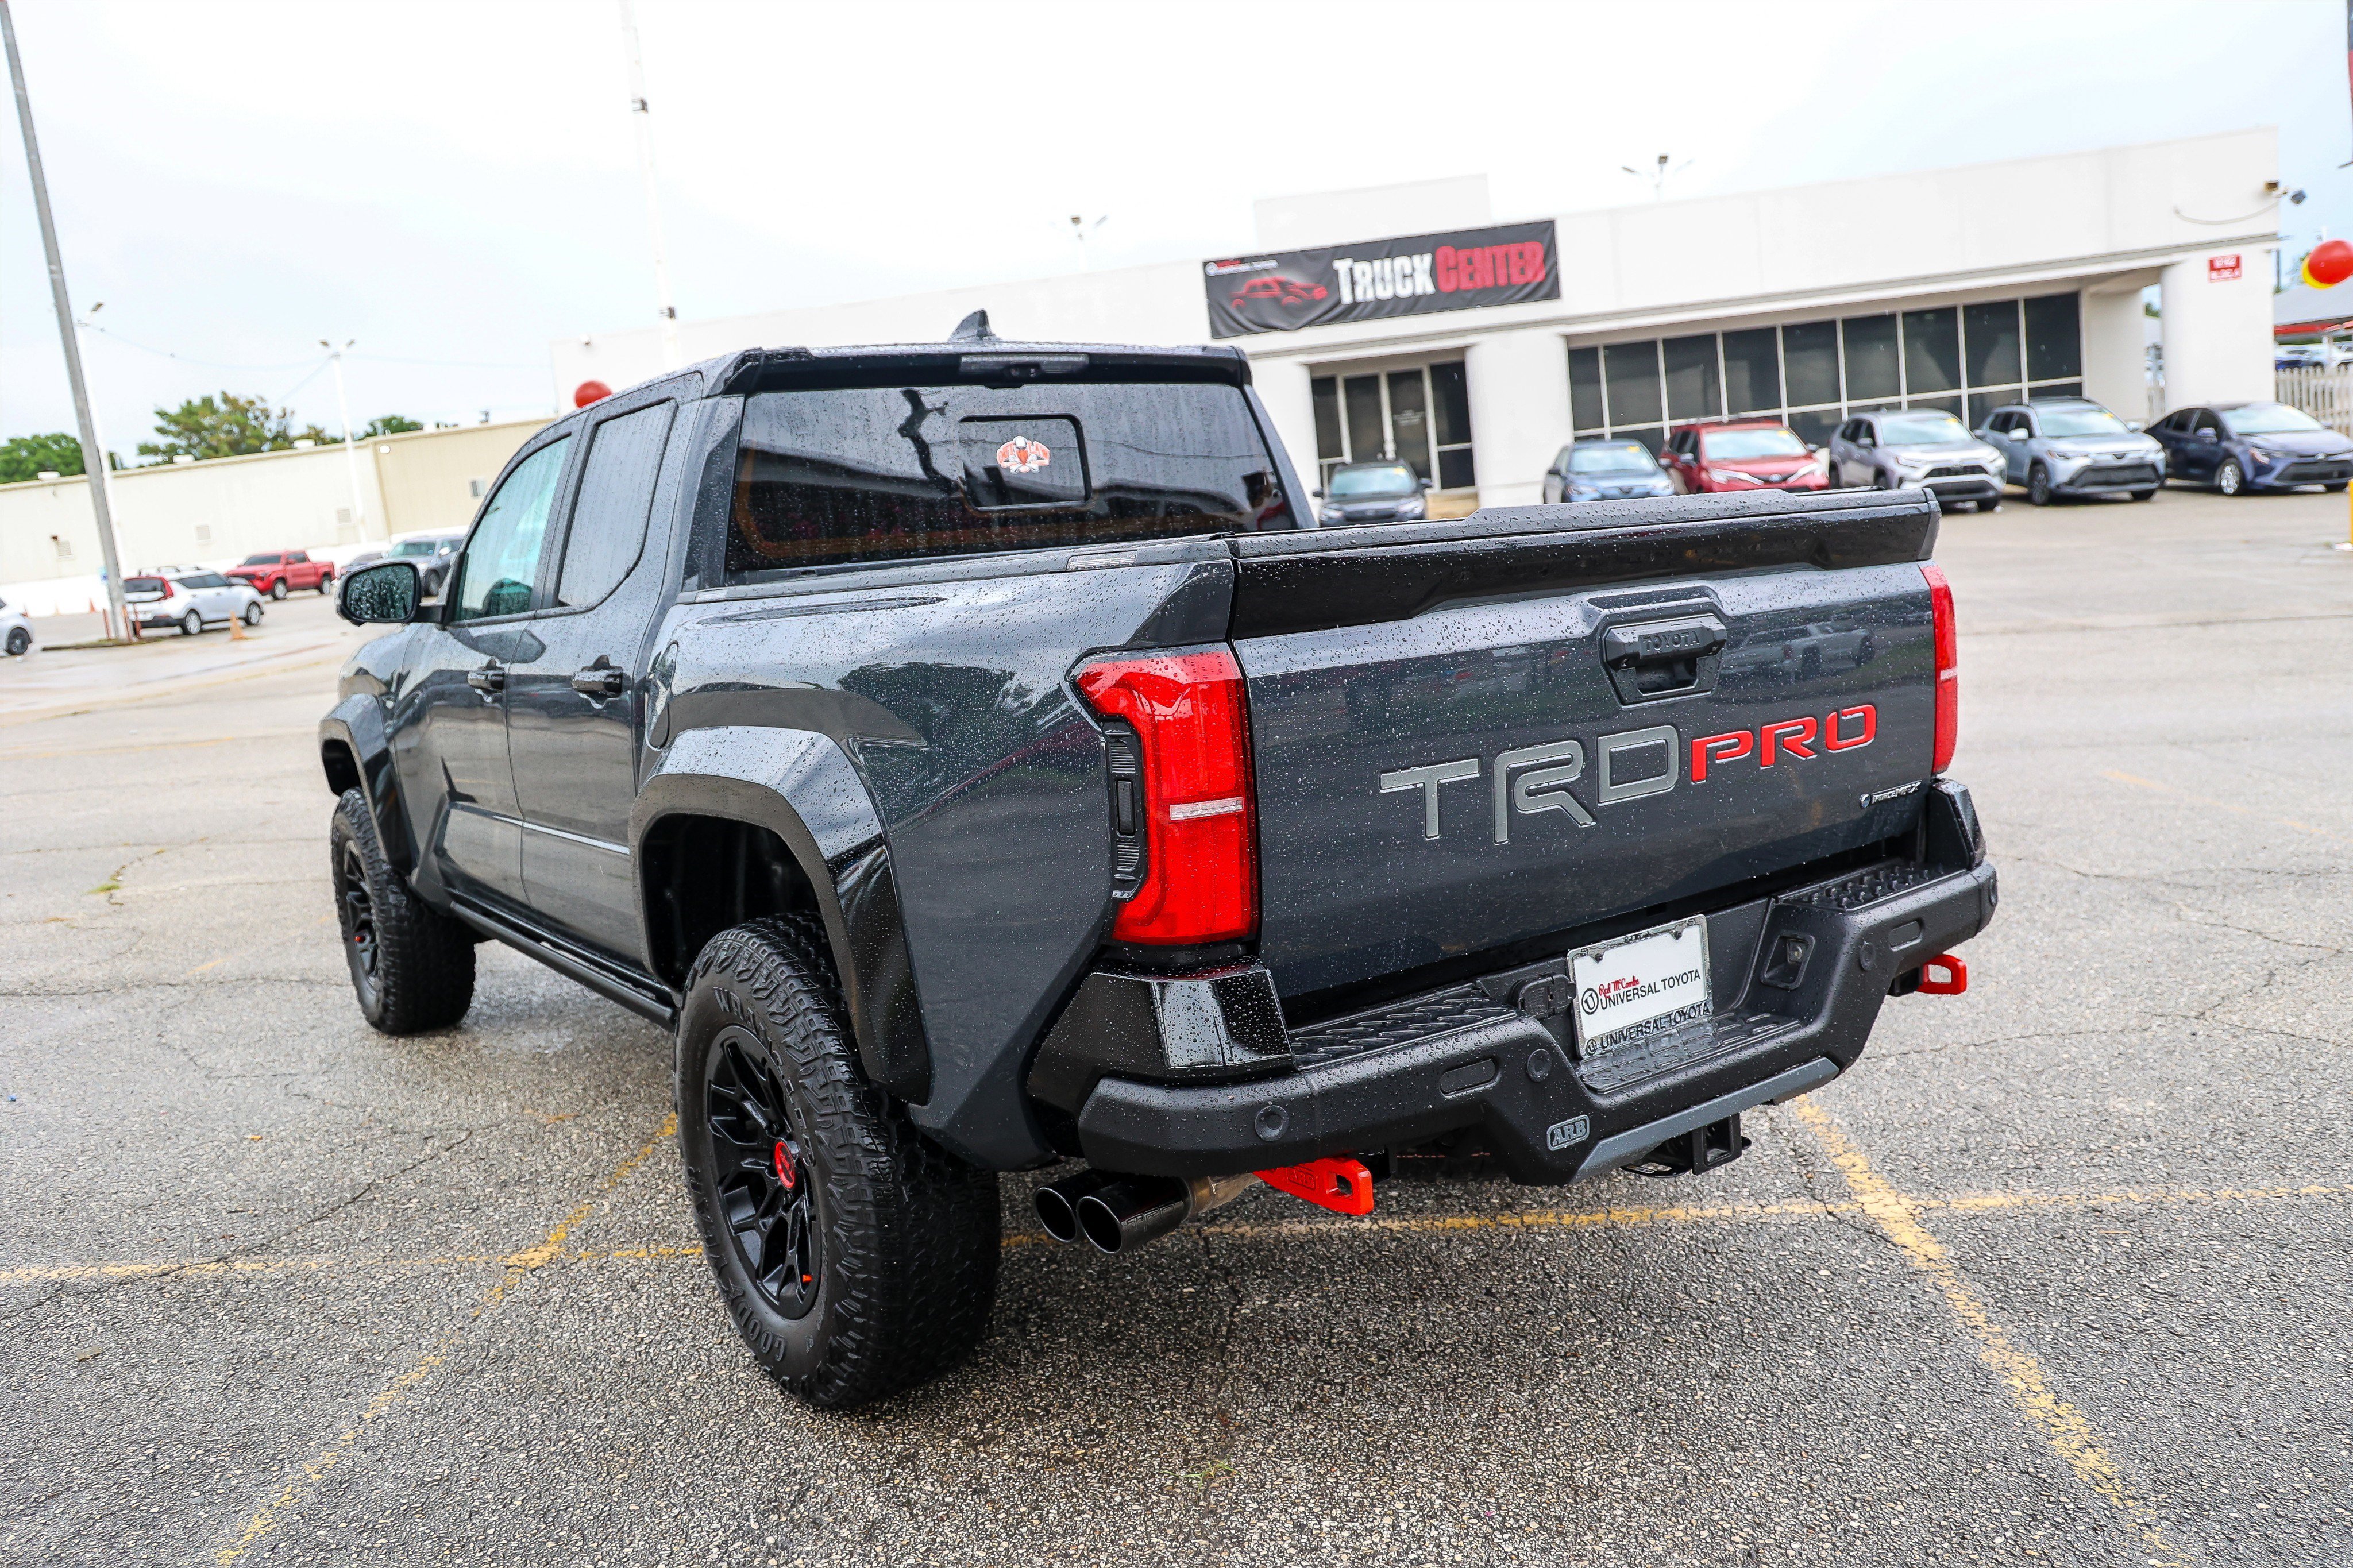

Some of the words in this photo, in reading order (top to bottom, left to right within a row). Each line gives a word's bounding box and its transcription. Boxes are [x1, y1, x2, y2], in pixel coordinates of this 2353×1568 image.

[1332, 252, 1436, 305] TRUCK
[1436, 241, 1546, 293] CENTER
[1643, 631, 1700, 652] TOYOTA
[1380, 725, 1679, 845] TRD
[1691, 704, 1877, 783] PRO
[1599, 982, 1611, 998] Red
[1600, 982, 1660, 1010] UNIVERSAL
[1661, 968, 1700, 991] TOYOTA
[1601, 1017, 1666, 1049] UNIVERSAL
[1667, 1002, 1711, 1026] TOYOTA
[1552, 1121, 1586, 1146] ARB
